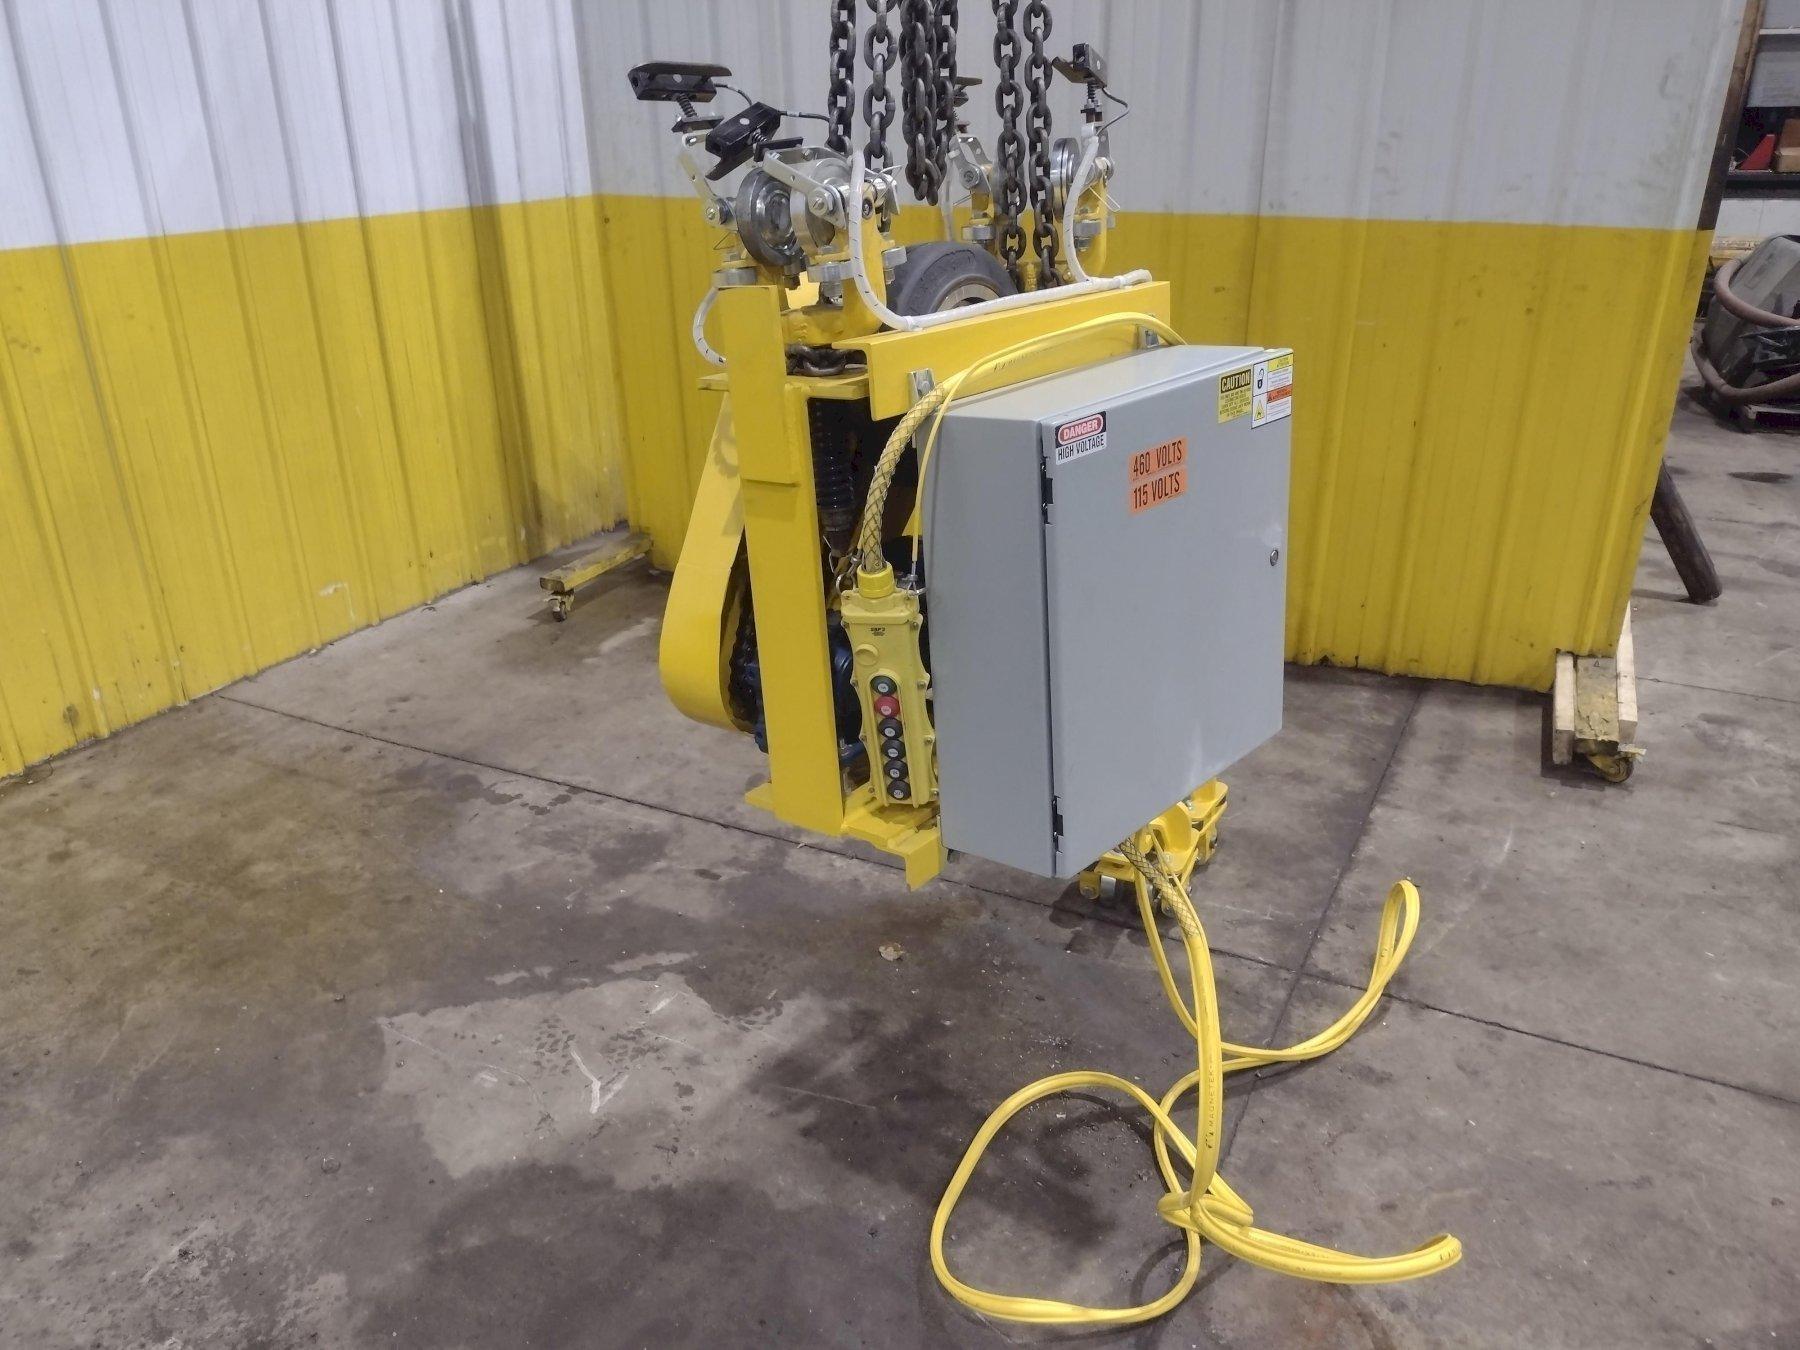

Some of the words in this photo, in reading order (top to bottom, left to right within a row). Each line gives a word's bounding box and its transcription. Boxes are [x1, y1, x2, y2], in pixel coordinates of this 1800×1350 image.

[1221, 371, 1250, 392] CAUTION
[1063, 420, 1098, 439] DANGER
[1058, 447, 1074, 460] HIGH
[1076, 434, 1104, 454] VOLTAGE
[1133, 452, 1151, 477] 460
[1156, 440, 1182, 468] VOLTS
[1133, 484, 1148, 509] 115
[1151, 472, 1180, 501] VOLTS
